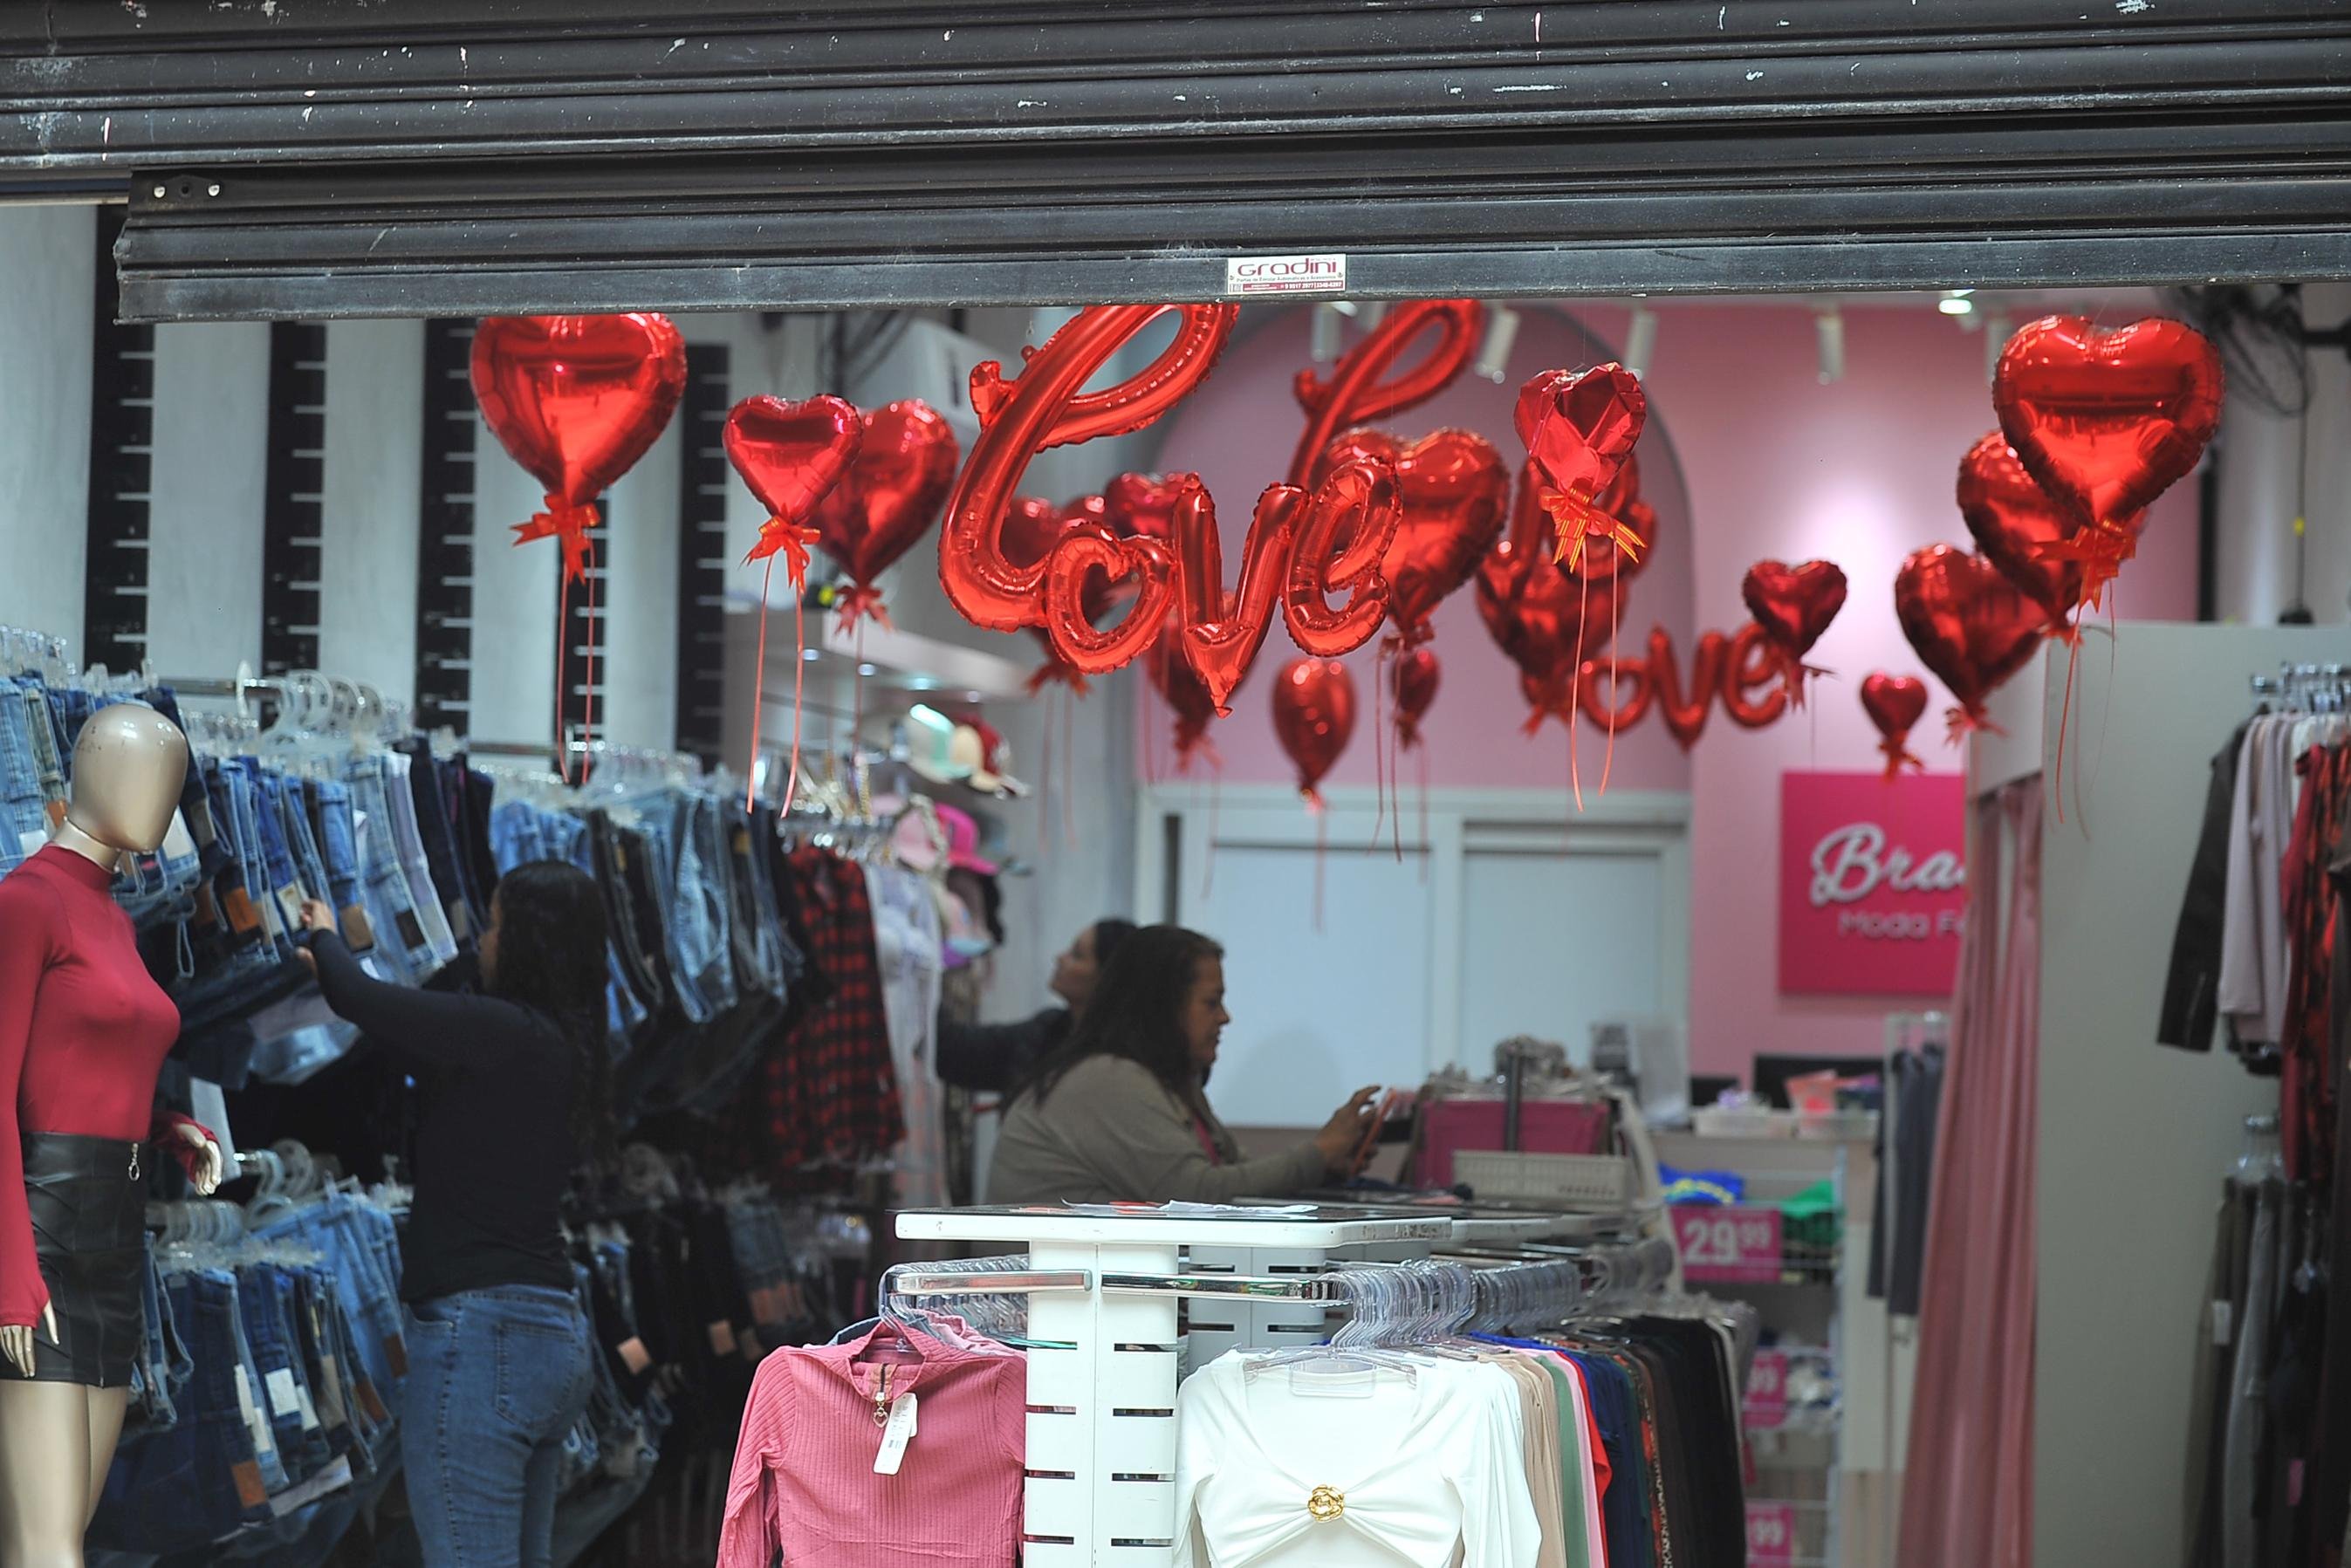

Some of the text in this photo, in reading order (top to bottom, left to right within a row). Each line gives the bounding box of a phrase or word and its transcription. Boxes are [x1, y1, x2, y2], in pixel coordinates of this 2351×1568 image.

[1237, 258, 1337, 277] Gradini
[1576, 620, 1788, 753] ove
[1809, 822, 1965, 907] Bra
